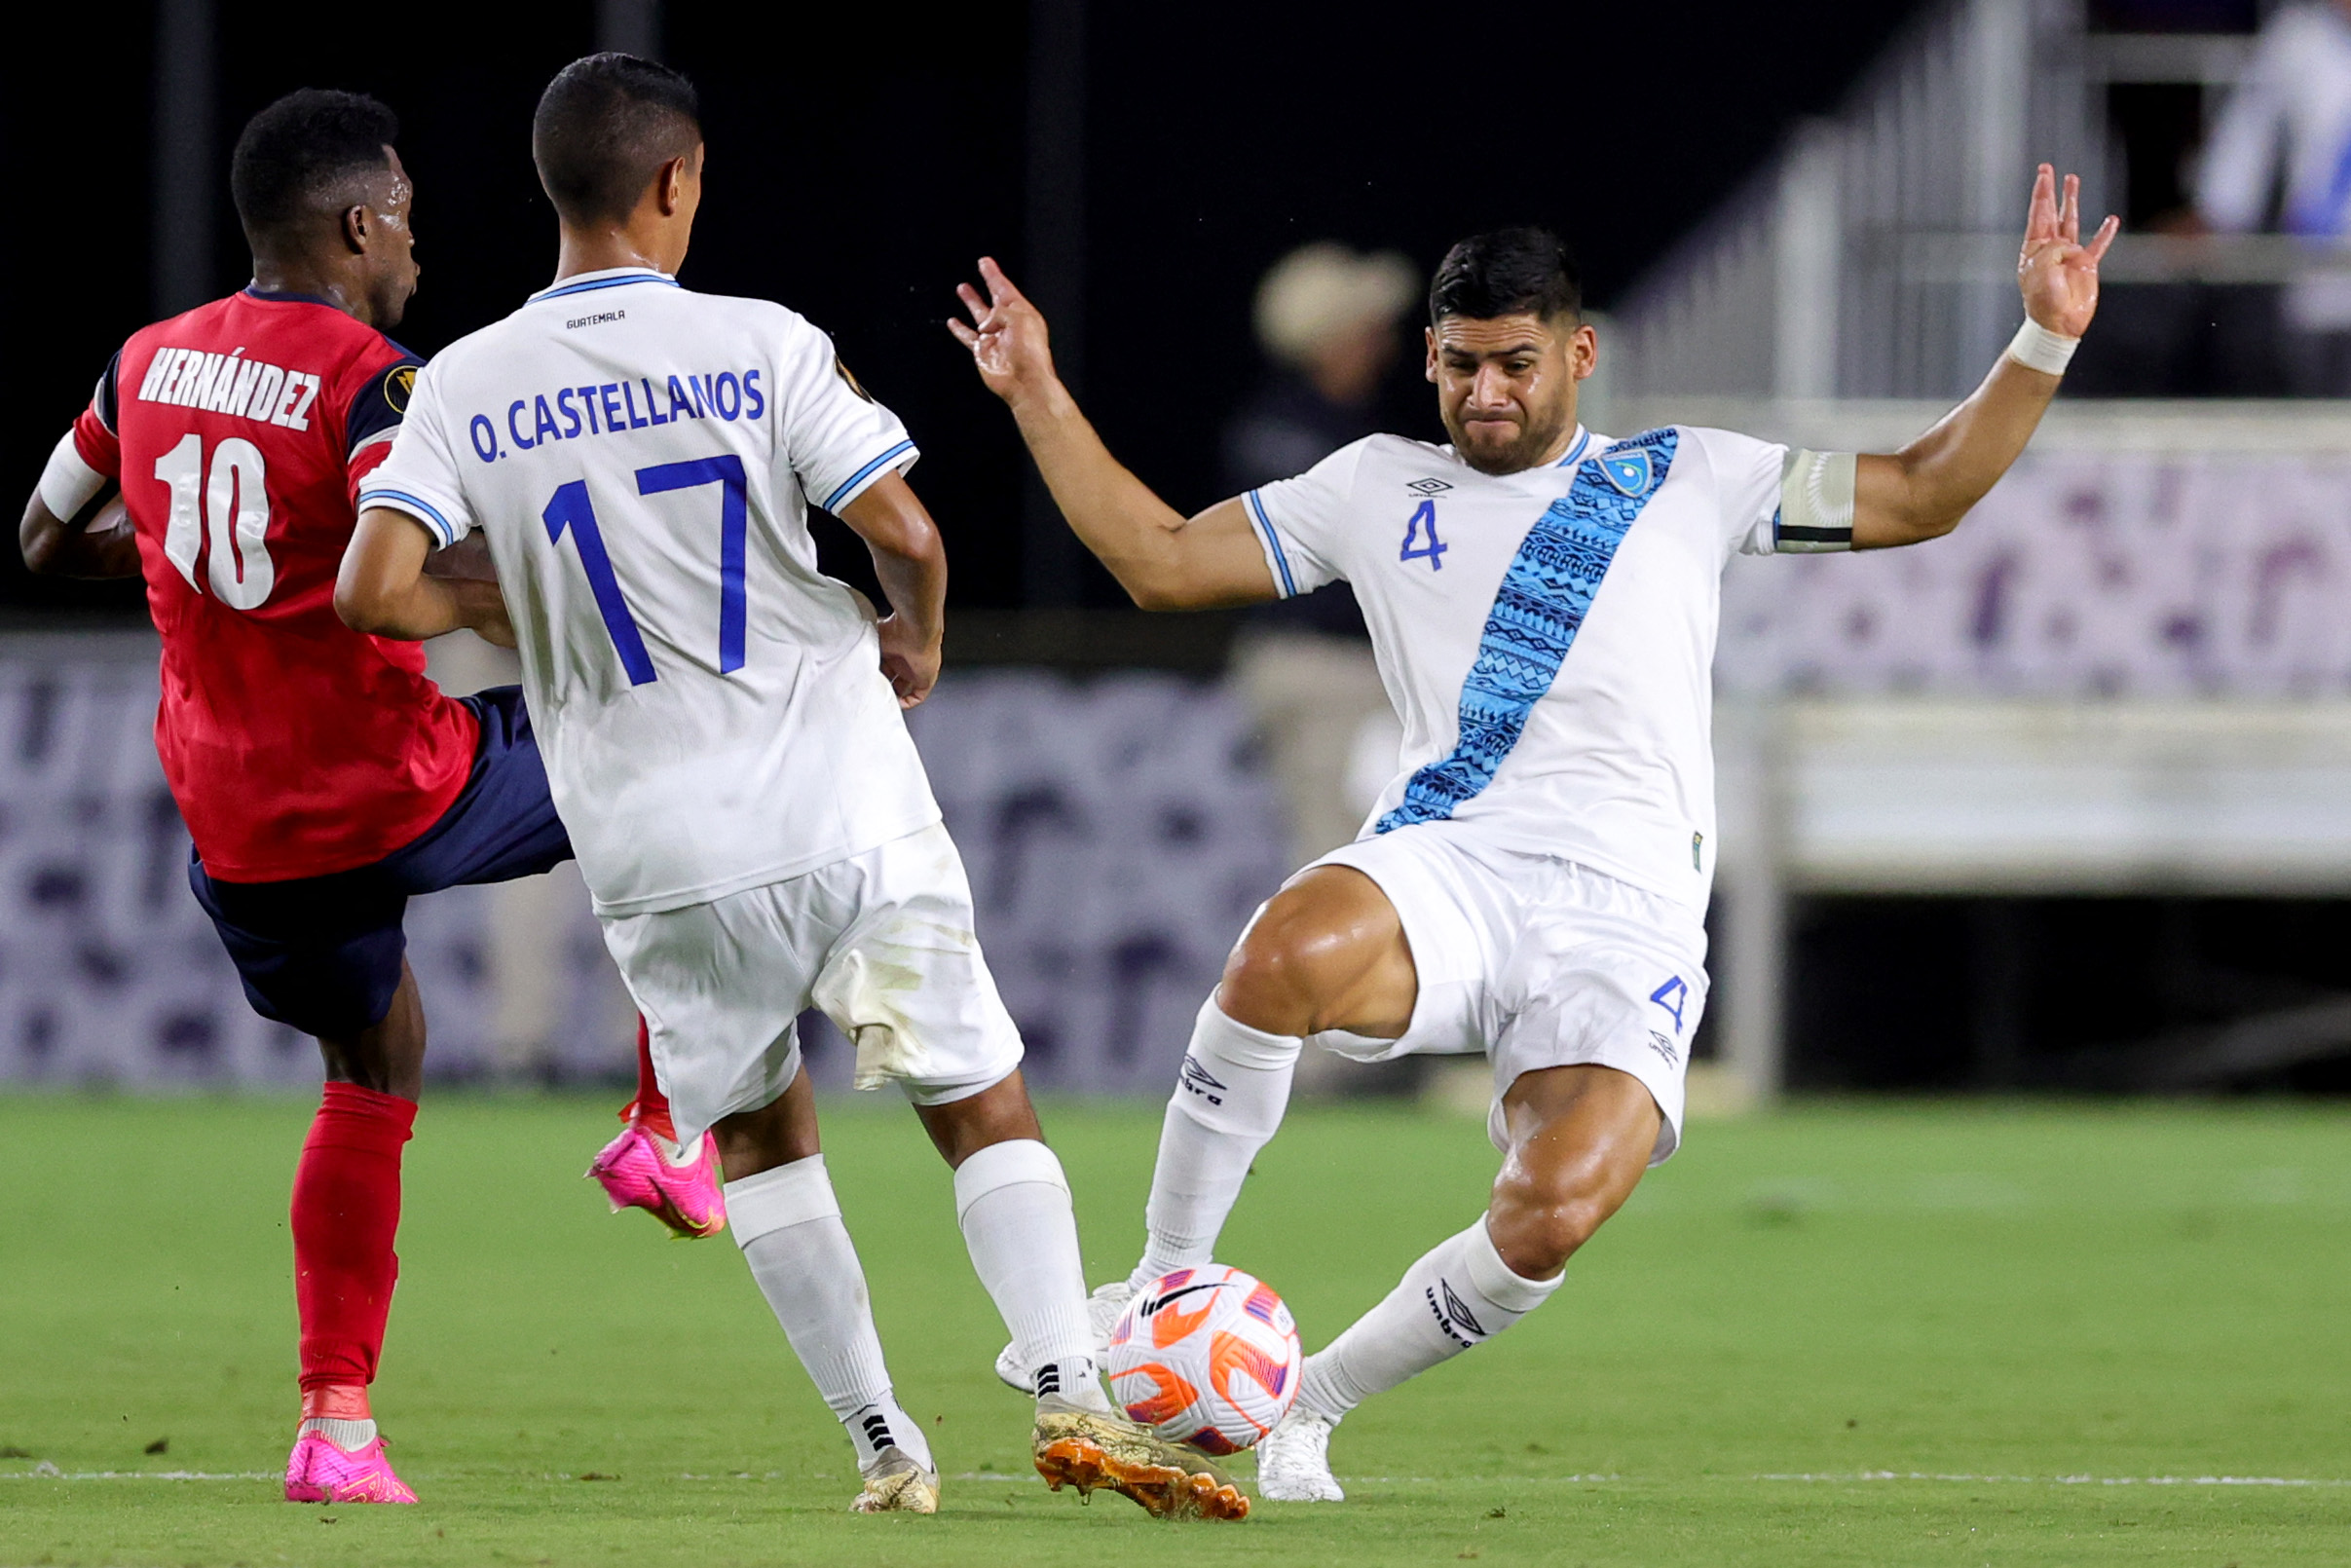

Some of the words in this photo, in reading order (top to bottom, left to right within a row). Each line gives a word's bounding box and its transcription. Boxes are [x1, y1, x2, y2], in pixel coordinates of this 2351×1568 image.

[566, 310, 624, 329] GUATEMALA
[138, 348, 320, 431] HERNÁNDEZ
[469, 414, 506, 464] O.
[507, 369, 765, 450] CASTELLANOS
[154, 433, 275, 611] 10
[1400, 500, 1447, 572] 4
[541, 454, 747, 686] 17
[1650, 975, 1688, 1036] 4
[1426, 1287, 1473, 1348] umbro
